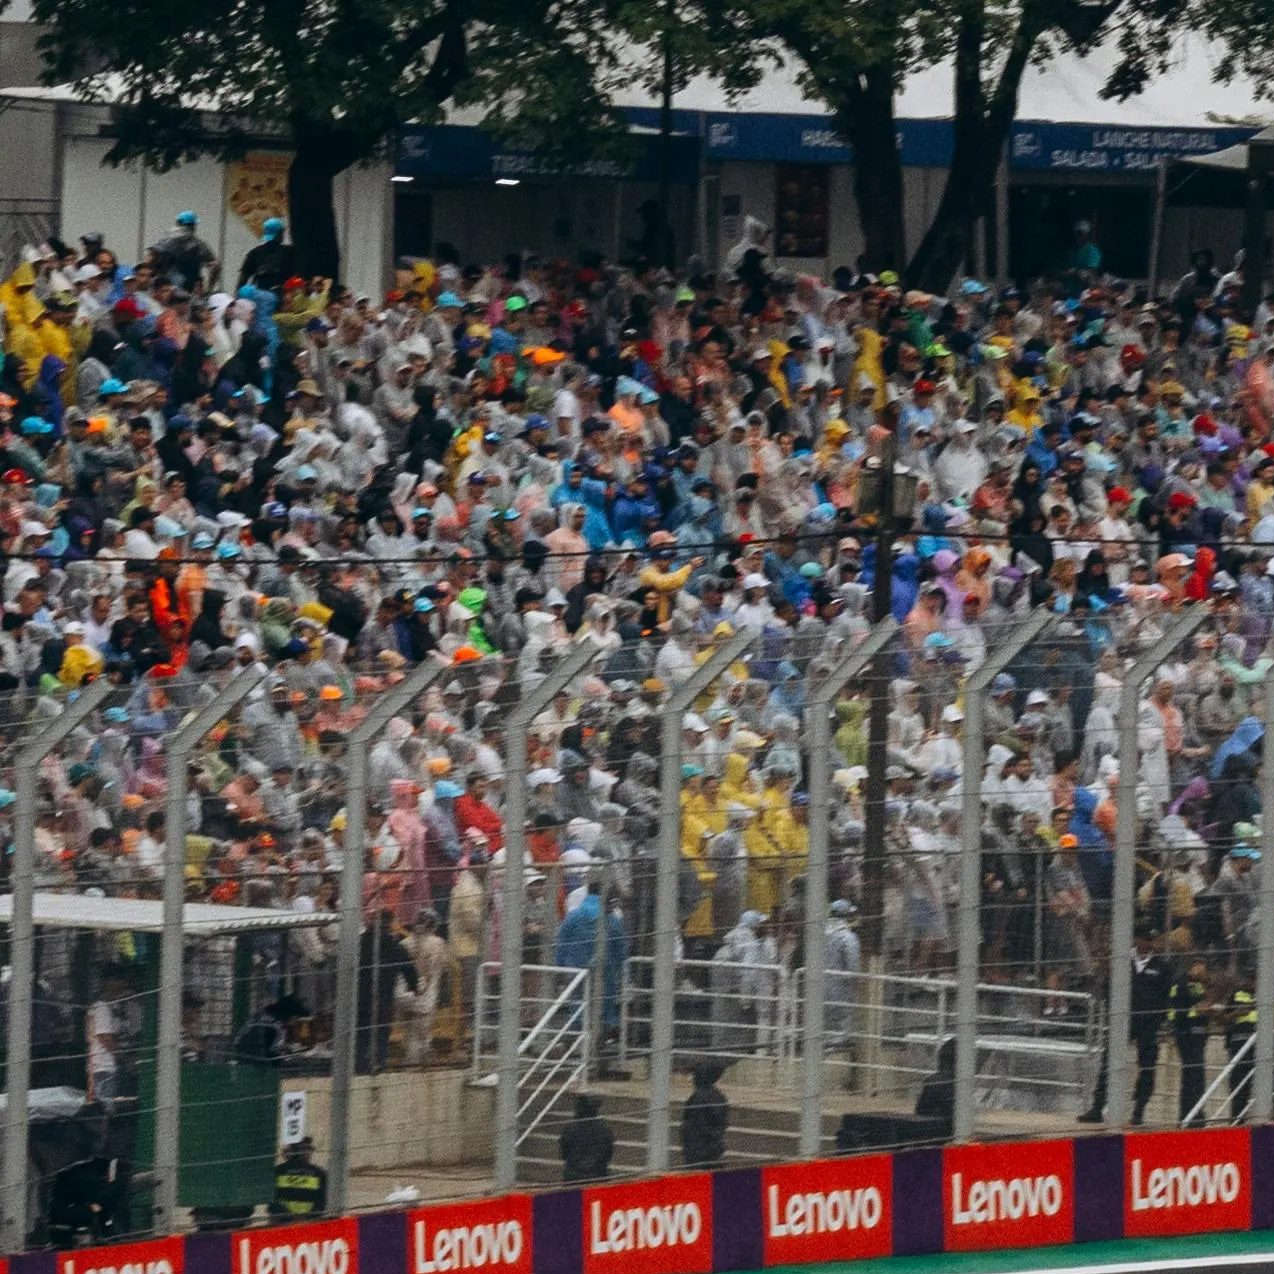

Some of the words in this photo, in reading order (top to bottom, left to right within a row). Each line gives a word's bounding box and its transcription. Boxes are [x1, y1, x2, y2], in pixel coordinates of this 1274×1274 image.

[768, 1184, 883, 1238] Lenovo
[951, 1172, 1063, 1225] Lenovo
[1131, 1158, 1241, 1212] Lenovo
[414, 1219, 523, 1274] Lenovo
[590, 1200, 702, 1255] Lenovo
